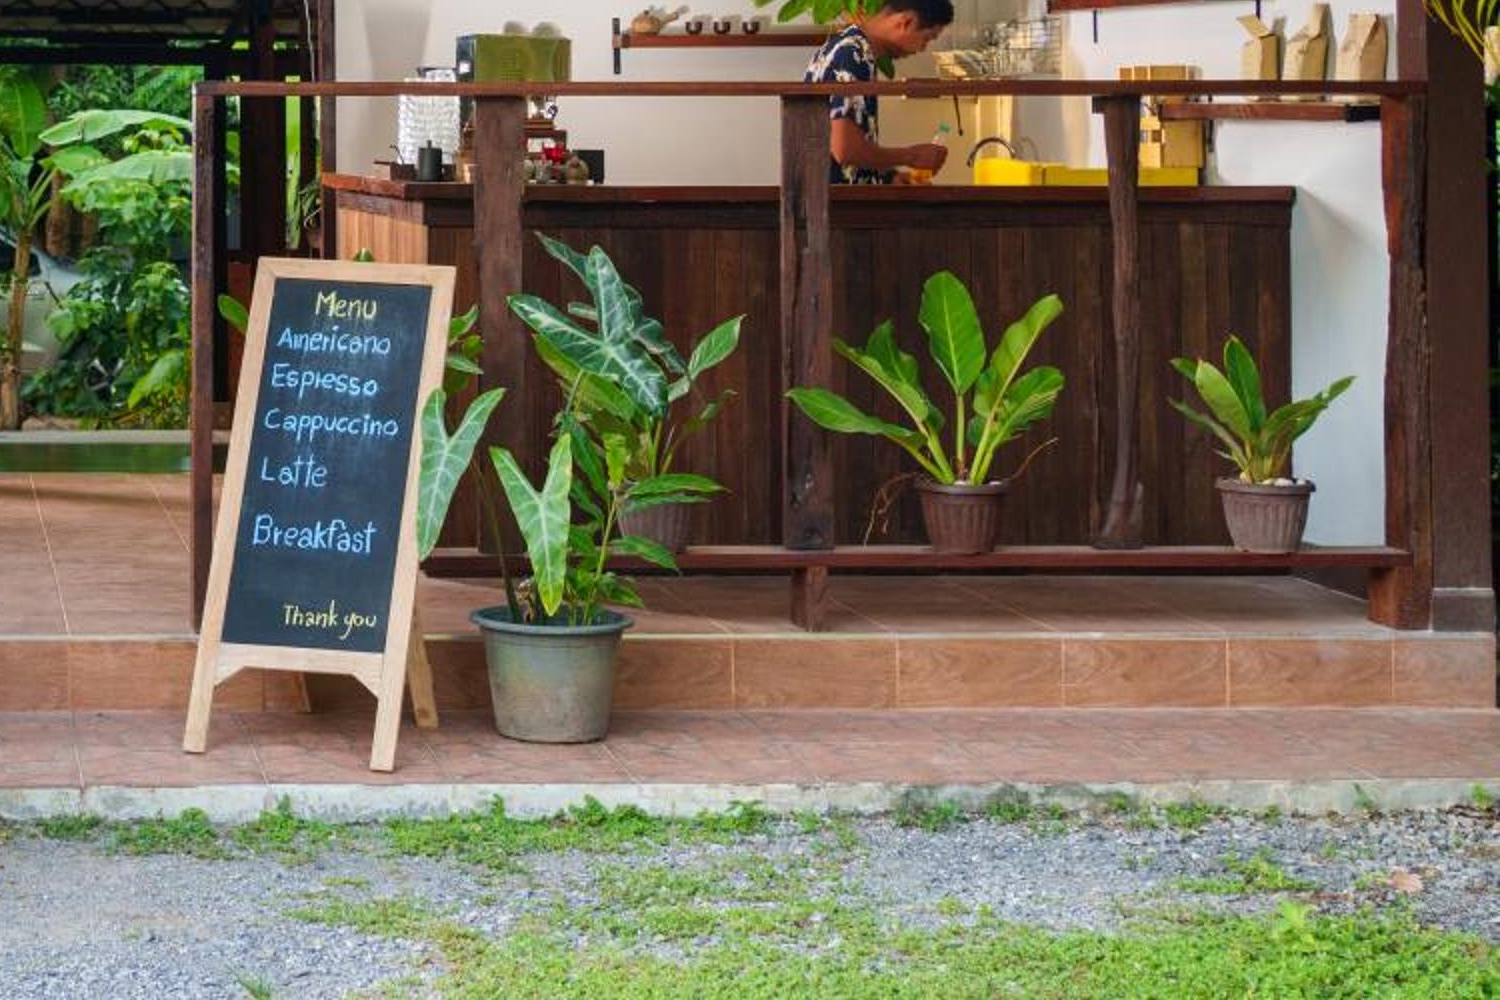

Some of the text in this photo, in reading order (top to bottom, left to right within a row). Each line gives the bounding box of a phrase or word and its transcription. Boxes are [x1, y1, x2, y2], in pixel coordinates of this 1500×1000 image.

[315, 290, 377, 319] Menu
[276, 325, 391, 355] Americano
[271, 362, 378, 399] Espresso
[264, 407, 399, 442] Cappuccino
[261, 455, 328, 488] Latte
[253, 513, 377, 553] Breakfast
[284, 600, 377, 640] Thank you
